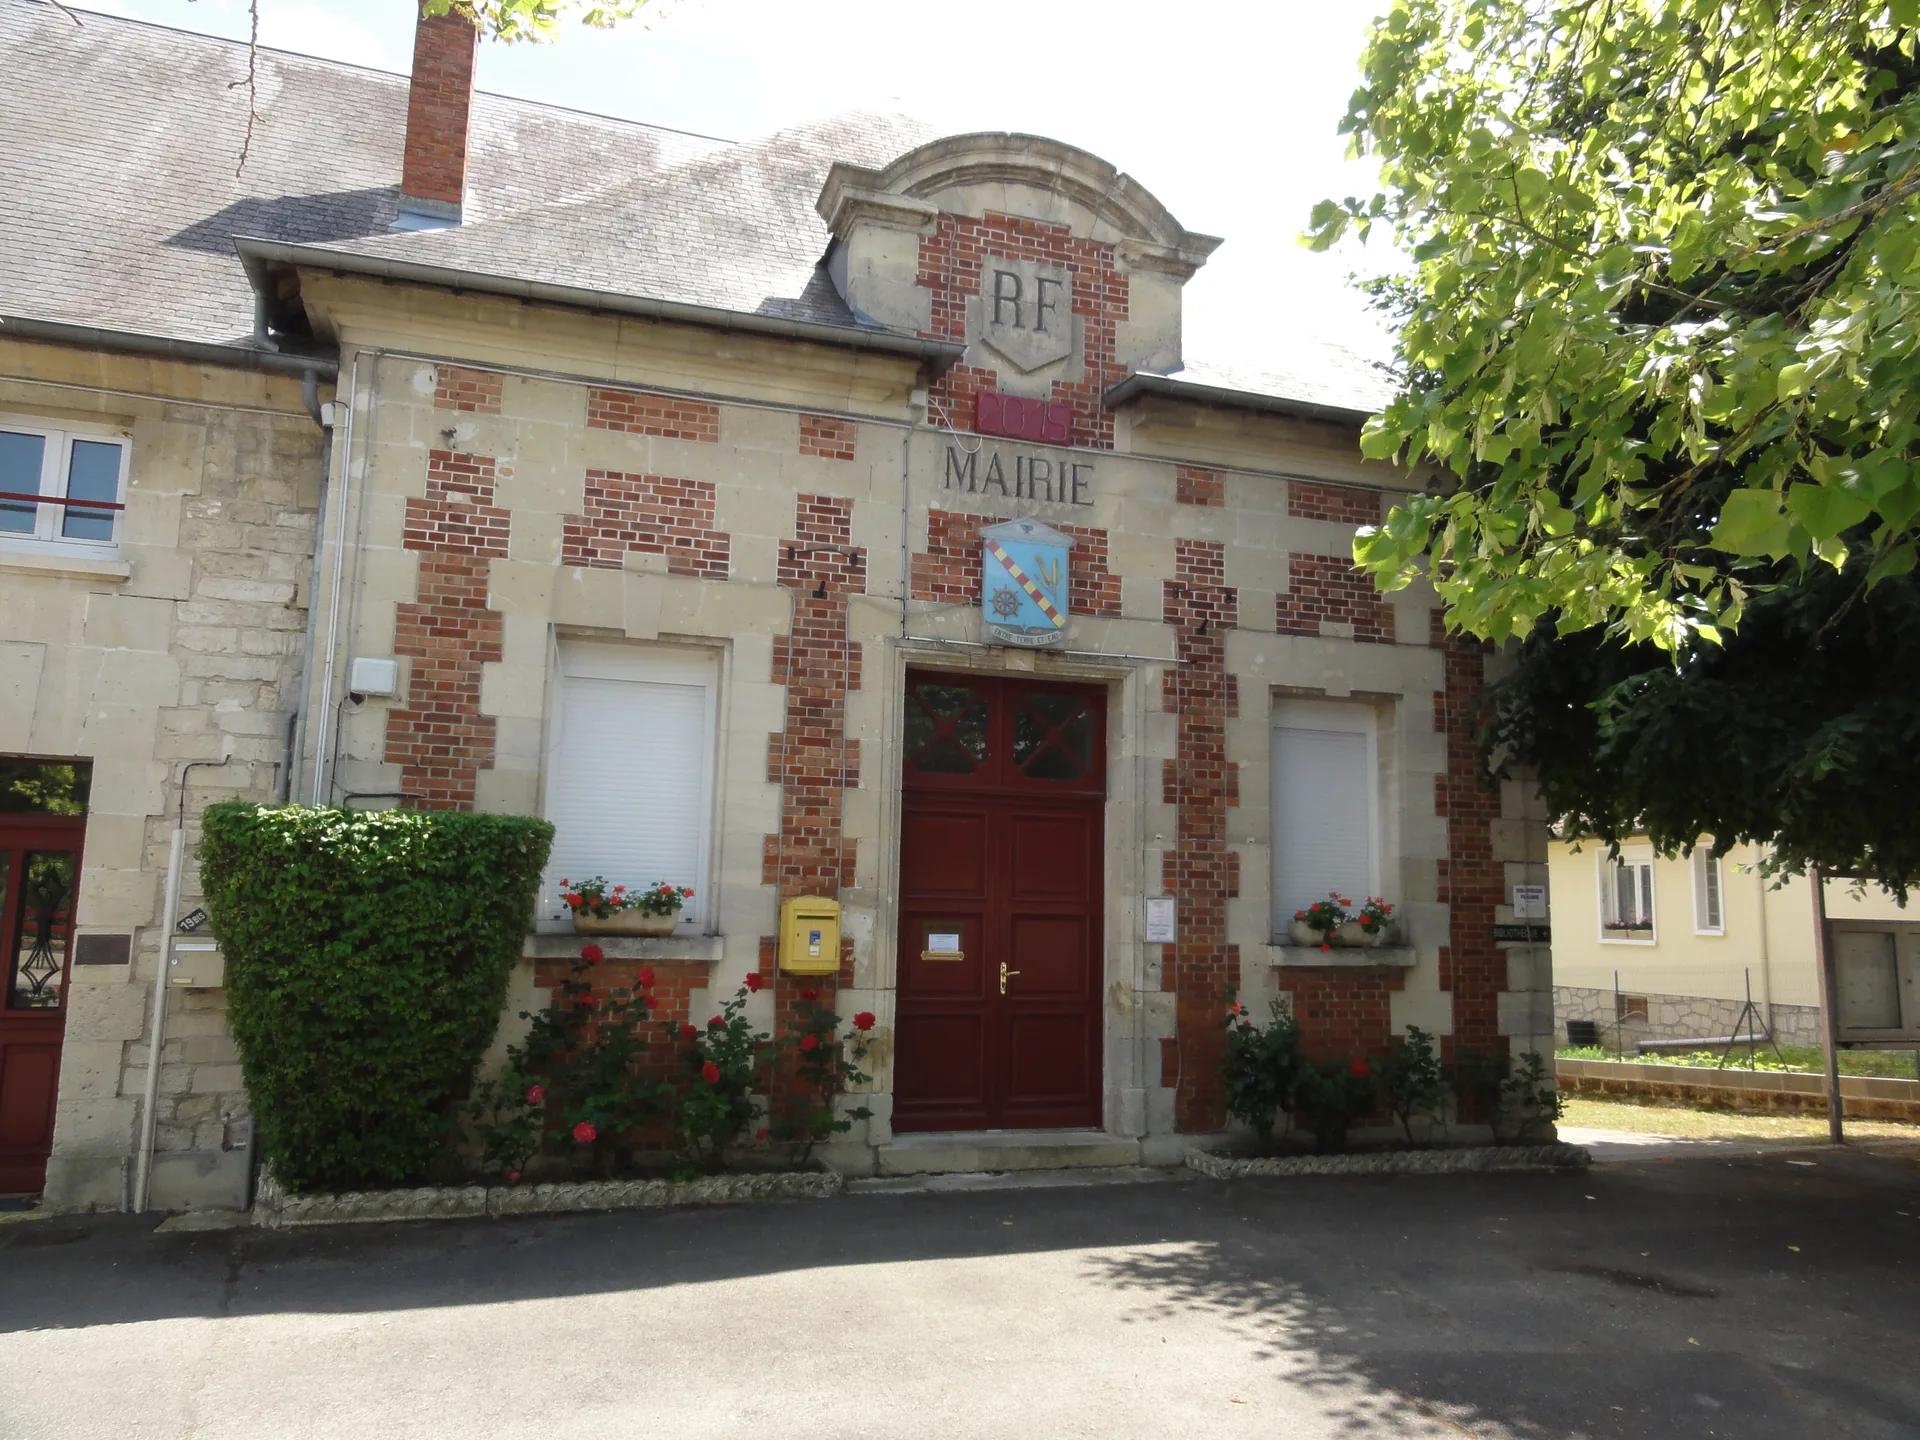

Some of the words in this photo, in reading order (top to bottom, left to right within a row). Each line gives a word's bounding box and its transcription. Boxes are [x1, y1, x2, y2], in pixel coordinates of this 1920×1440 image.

[979, 393, 1067, 441] 2015
[944, 446, 1095, 507] MAIRIE
[994, 628, 1012, 641] ENTRE
[1016, 636, 1034, 644] TERRE
[1047, 633, 1059, 641] EAU
